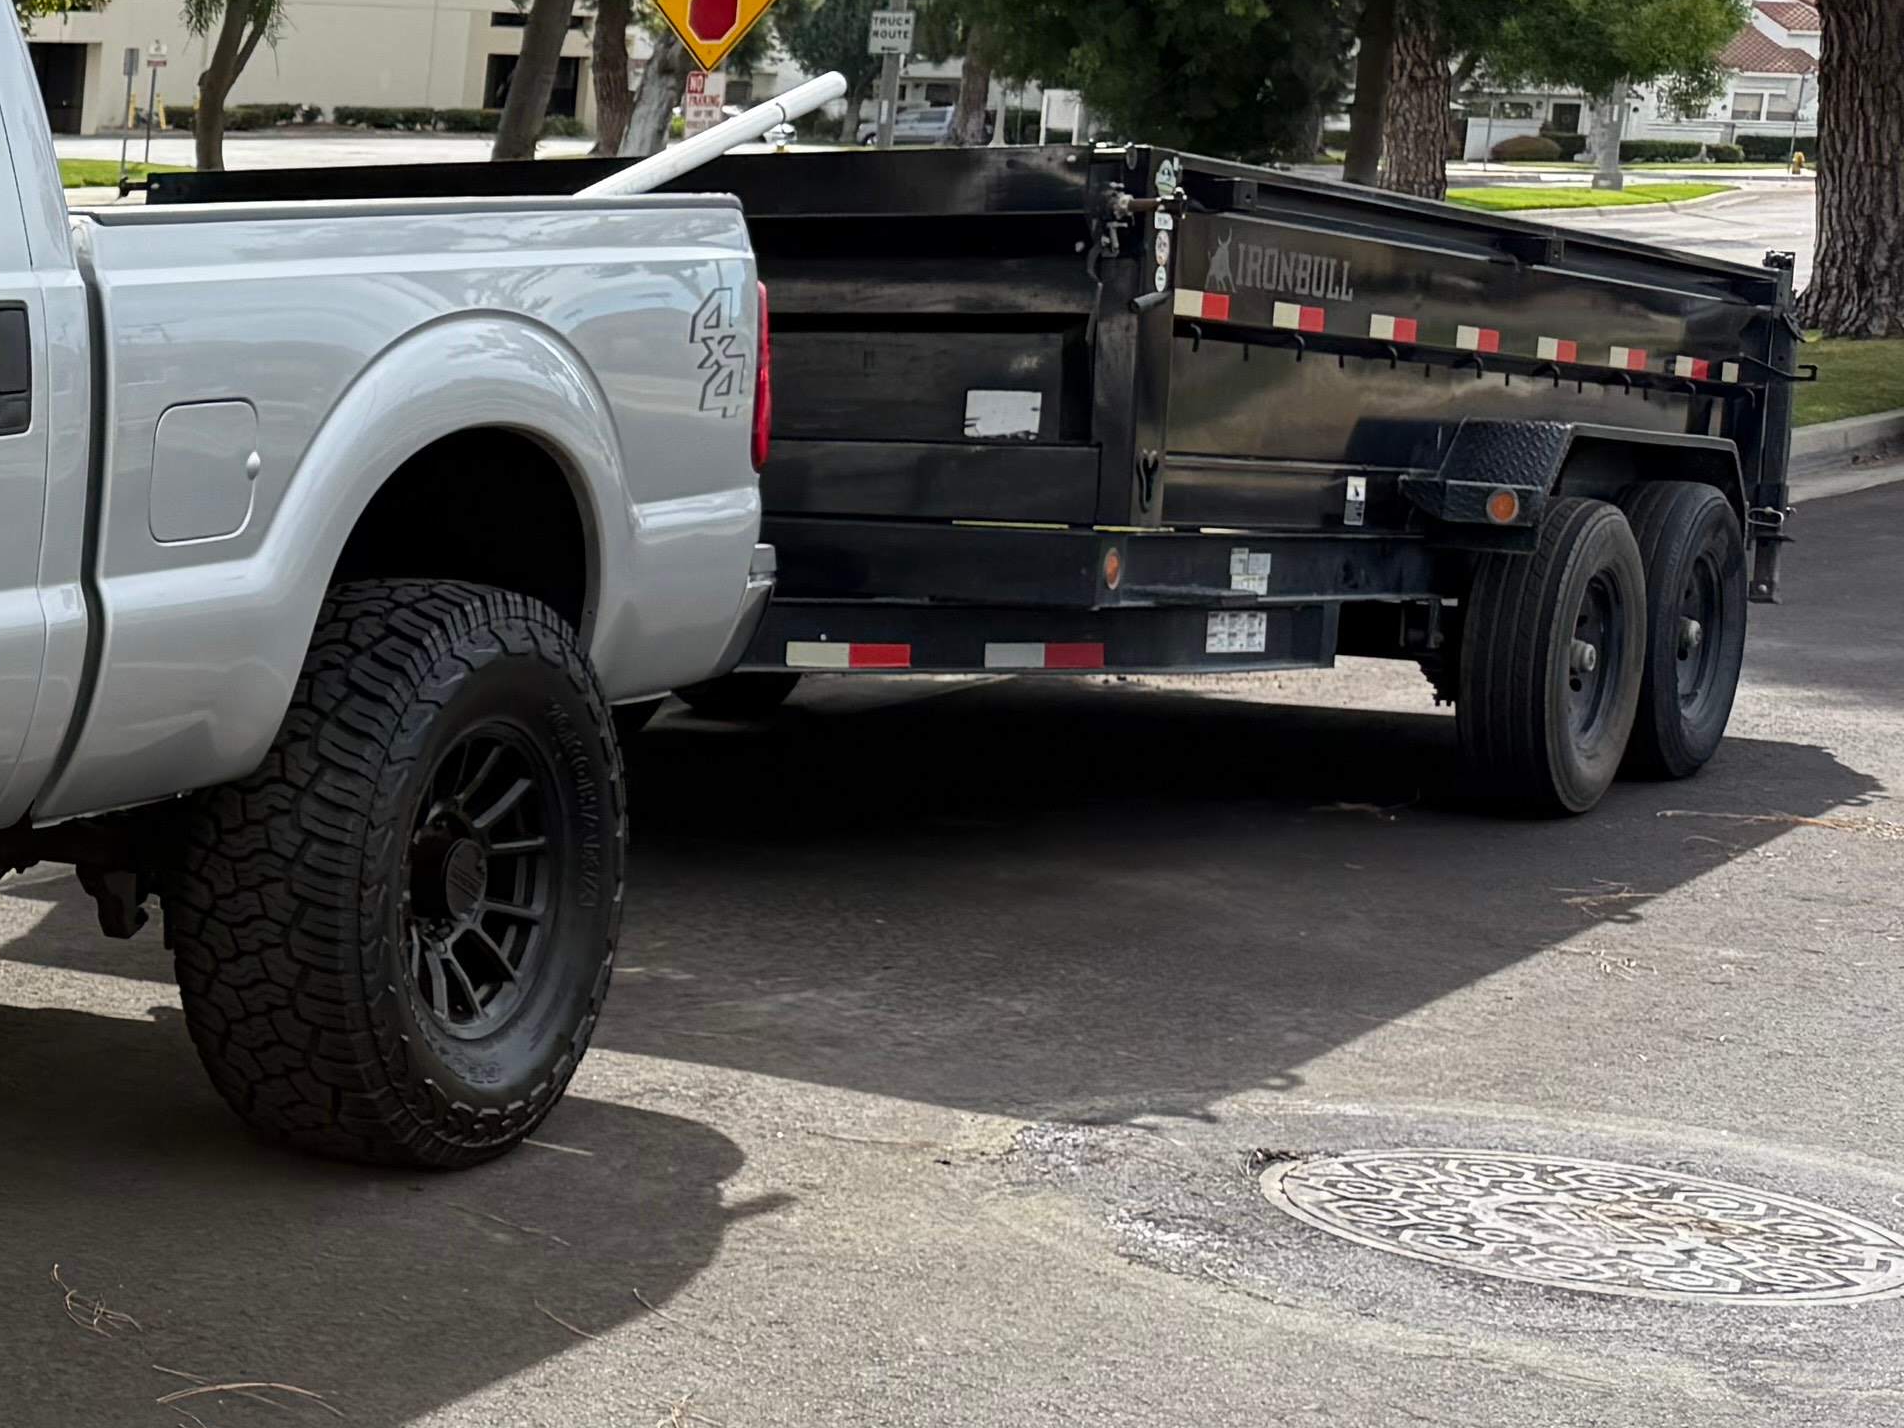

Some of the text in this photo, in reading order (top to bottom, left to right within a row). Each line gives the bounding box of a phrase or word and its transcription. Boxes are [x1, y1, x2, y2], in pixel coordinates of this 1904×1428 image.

[872, 16, 911, 27] TRUCK
[872, 29, 910, 40] ROUTE
[689, 75, 704, 92] NO
[688, 95, 721, 107] PARKING
